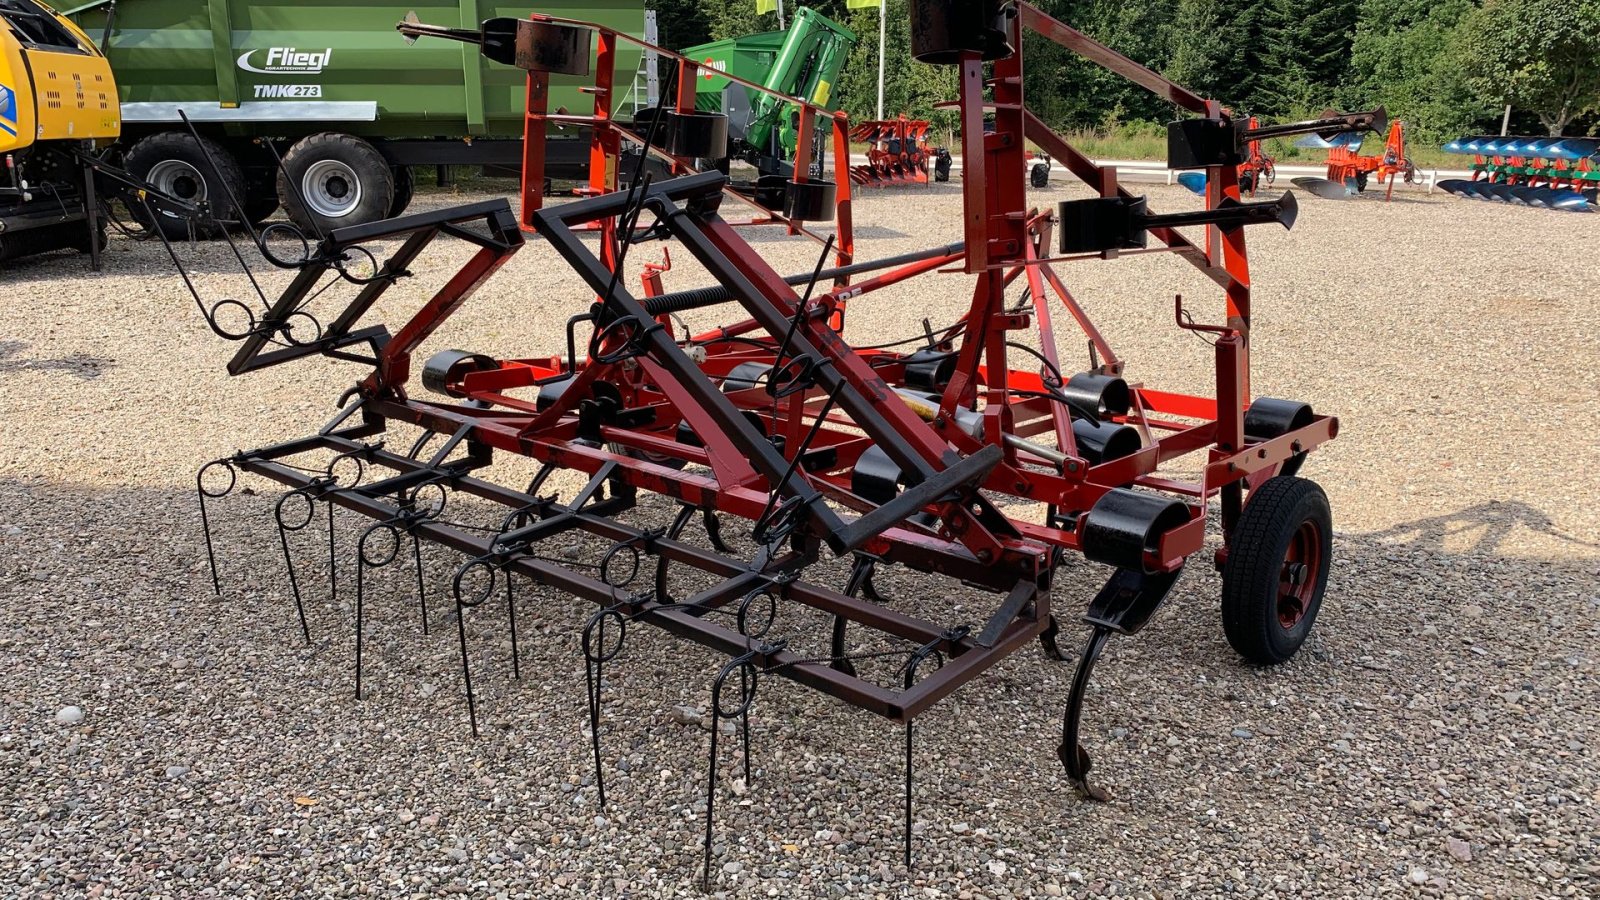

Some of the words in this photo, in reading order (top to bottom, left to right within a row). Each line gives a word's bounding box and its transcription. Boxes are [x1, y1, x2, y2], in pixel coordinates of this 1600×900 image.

[266, 47, 332, 71] Fliegl
[253, 85, 290, 98] TMK
[294, 86, 318, 96] 273
